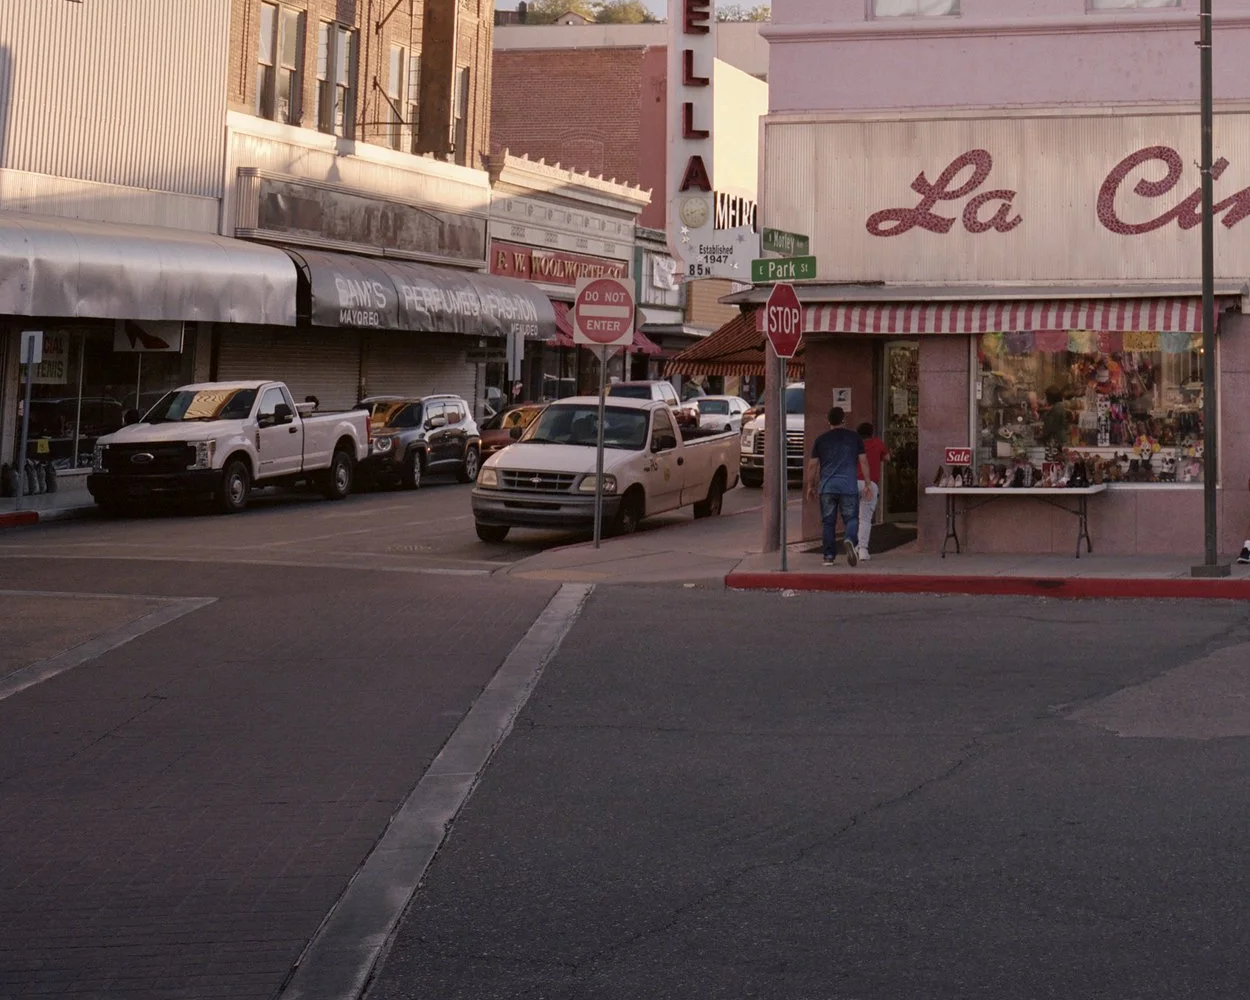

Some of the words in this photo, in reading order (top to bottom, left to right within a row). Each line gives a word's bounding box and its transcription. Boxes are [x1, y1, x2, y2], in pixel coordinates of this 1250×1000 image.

[865, 148, 1023, 237] La
[699, 244, 734, 255] Established
[773, 231, 795, 256] Morley
[513, 252, 526, 273] W.
[531, 254, 605, 279] WOOLWORTH
[704, 255, 729, 264] 1947
[759, 265, 764, 275] E
[768, 260, 796, 278] Park
[800, 263, 808, 273] St
[402, 285, 480, 317] PERFUMES
[490, 292, 538, 322] FASHION
[585, 290, 599, 301] DO
[605, 291, 626, 303] NOT
[339, 310, 380, 327] MAYOREO
[586, 320, 621, 331] ENTER
[769, 305, 800, 335] STOP
[947, 451, 970, 462] Sale
